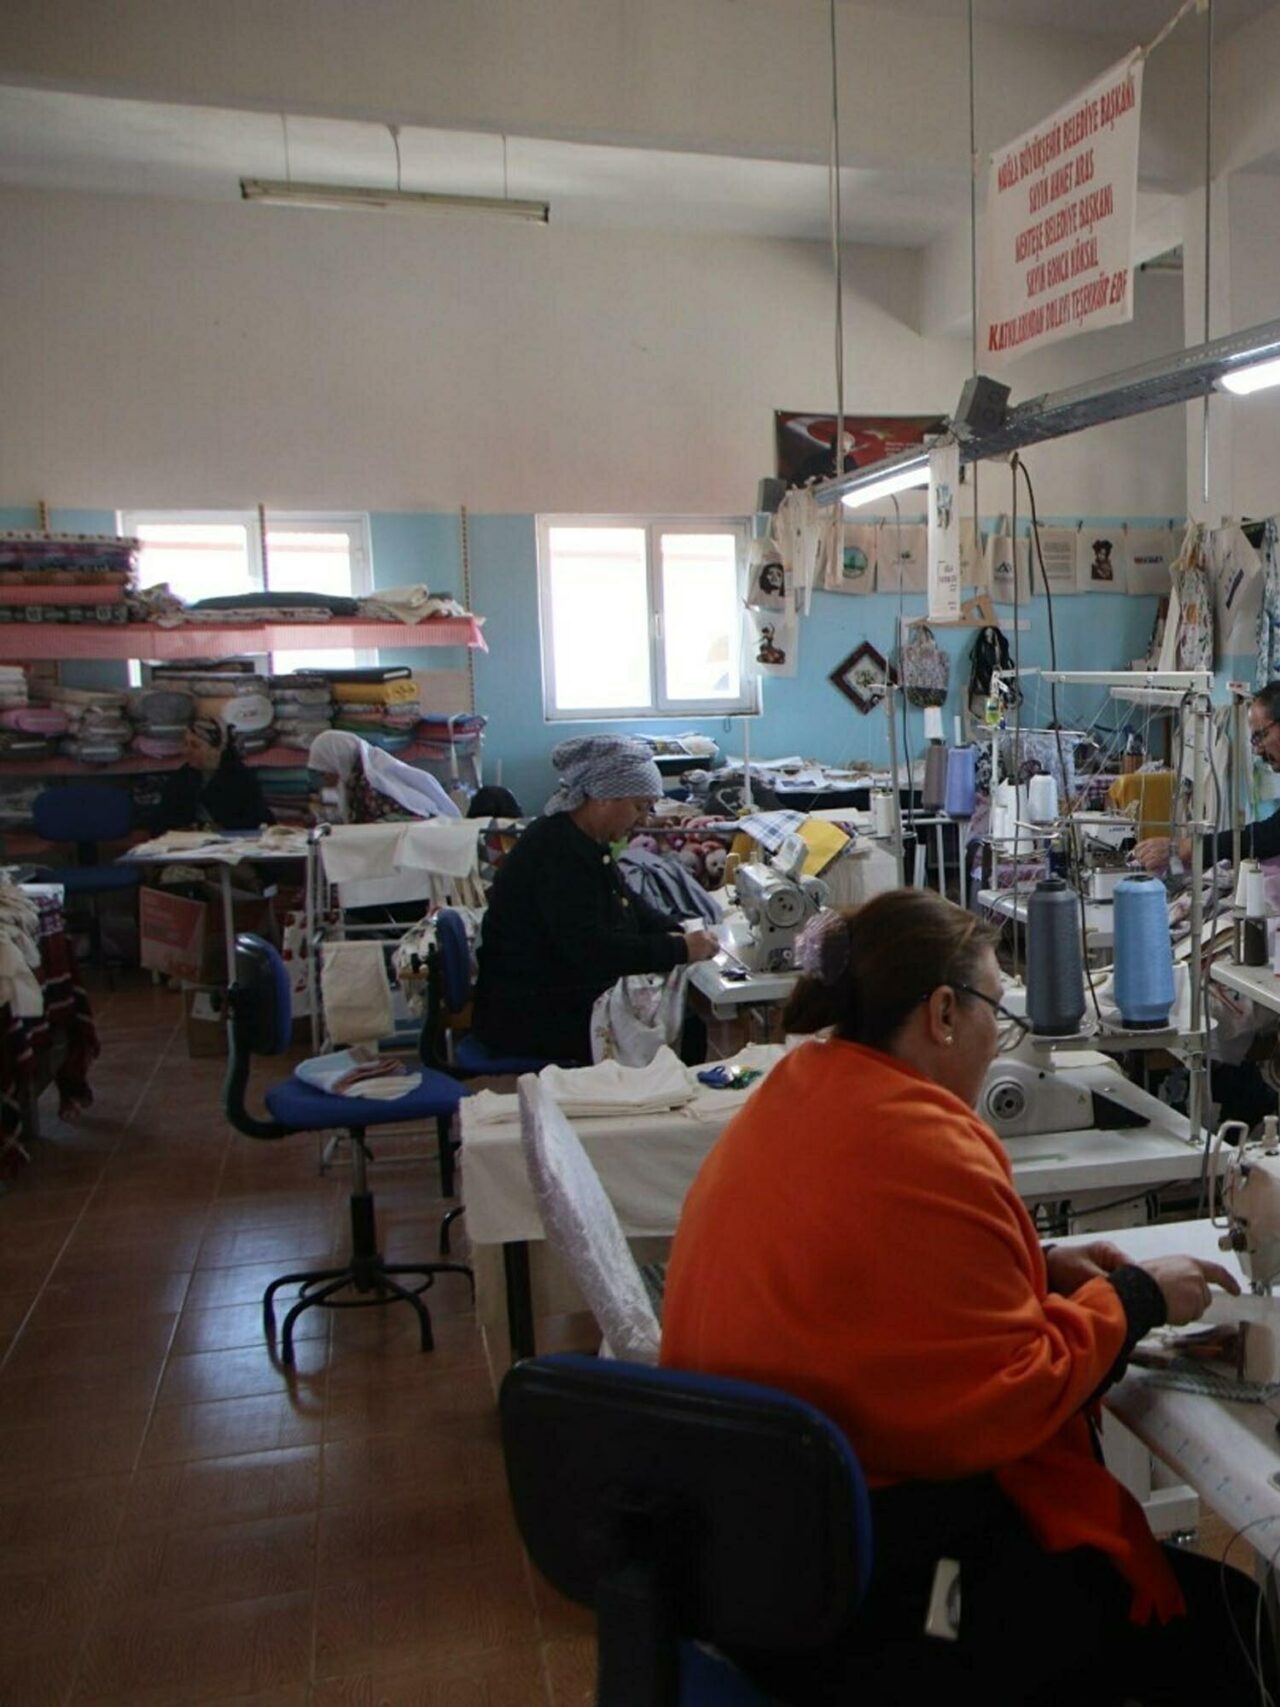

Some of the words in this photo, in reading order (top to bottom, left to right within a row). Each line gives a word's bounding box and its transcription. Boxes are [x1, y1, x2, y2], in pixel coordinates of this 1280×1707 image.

[1063, 100, 1098, 150] BELEDİYE
[1101, 79, 1135, 130] BAŞKANI
[1074, 148, 1095, 190] ARAS
[1045, 203, 1078, 253] BELEDİYE
[1079, 183, 1114, 233] BAŞKANI
